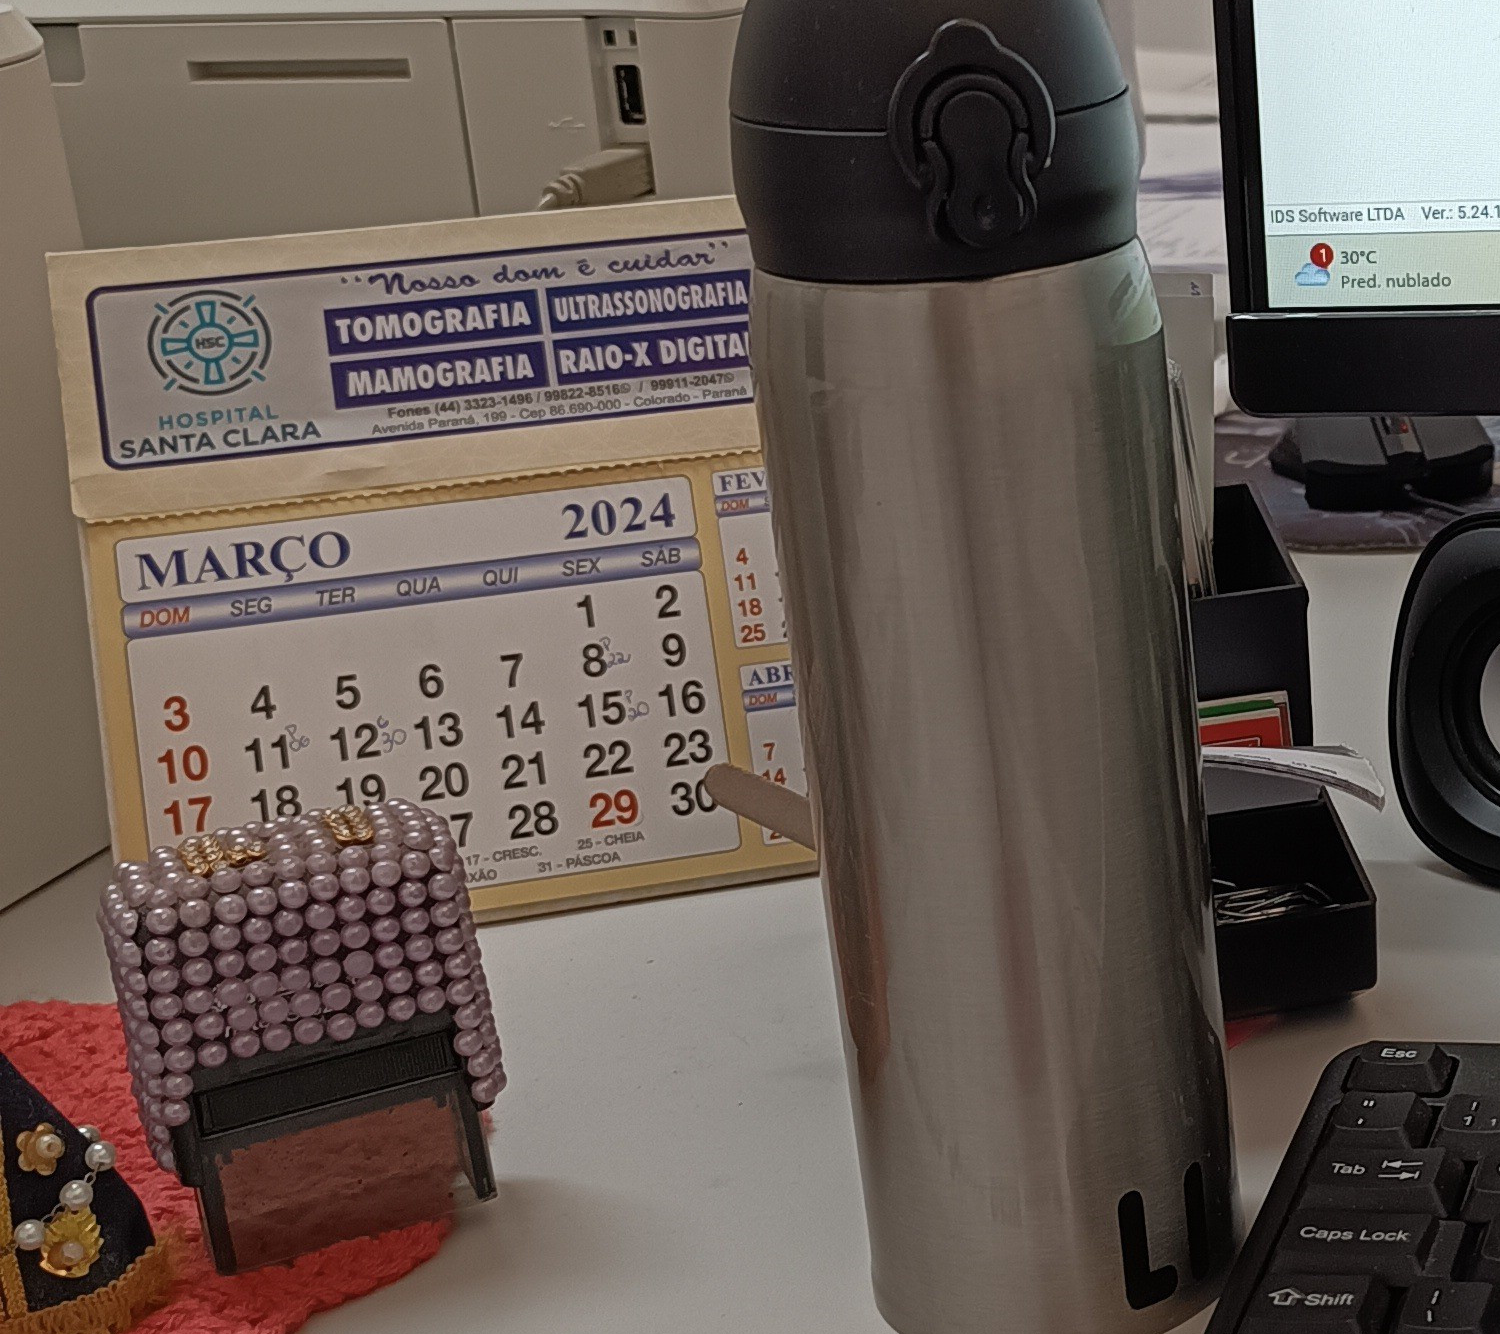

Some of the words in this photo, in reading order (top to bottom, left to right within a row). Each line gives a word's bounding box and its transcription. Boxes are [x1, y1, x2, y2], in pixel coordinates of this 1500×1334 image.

[1270, 208, 1295, 225] IDS
[1298, 206, 1364, 224] Software
[1367, 206, 1406, 223] LTDA
[1421, 205, 1454, 222] Ver.:
[1340, 272, 1381, 290] Pred.
[1386, 270, 1452, 290] nublado
[554, 280, 749, 324] ULTRASSONOGRAFIA
[336, 300, 532, 345] TOMOGRAFIA
[560, 339, 654, 377] RAIO-X
[346, 353, 536, 400] MAMOGRAFIA
[158, 404, 279, 432] HOSPITAL
[387, 405, 432, 420] Fones
[434, 400, 460, 417] (44)
[120, 430, 218, 461] SANTA
[222, 419, 323, 449] CLARA
[562, 491, 678, 542] 2024
[134, 531, 352, 592] MARÇO
[562, 555, 601, 578] SEX
[641, 544, 682, 569] SÁB
[396, 574, 442, 598] QUA
[482, 565, 519, 587] QUI
[229, 595, 273, 618] SEG
[316, 585, 357, 608] TER
[738, 597, 763, 617] 18
[139, 603, 192, 630] DOM
[576, 593, 596, 630] 1
[662, 631, 686, 668] 9
[163, 695, 191, 732] 3
[158, 743, 210, 786] 10
[508, 799, 559, 843] 28
[589, 787, 639, 831] 29
[577, 838, 593, 851] 25
[604, 831, 645, 847] CHEIA
[1380, 1046, 1418, 1061] Esc
[1330, 1161, 1366, 1177] Tab
[1299, 1225, 1348, 1245] Caps
[1355, 1225, 1410, 1243] Lock
[1304, 1290, 1355, 1308] Shift
